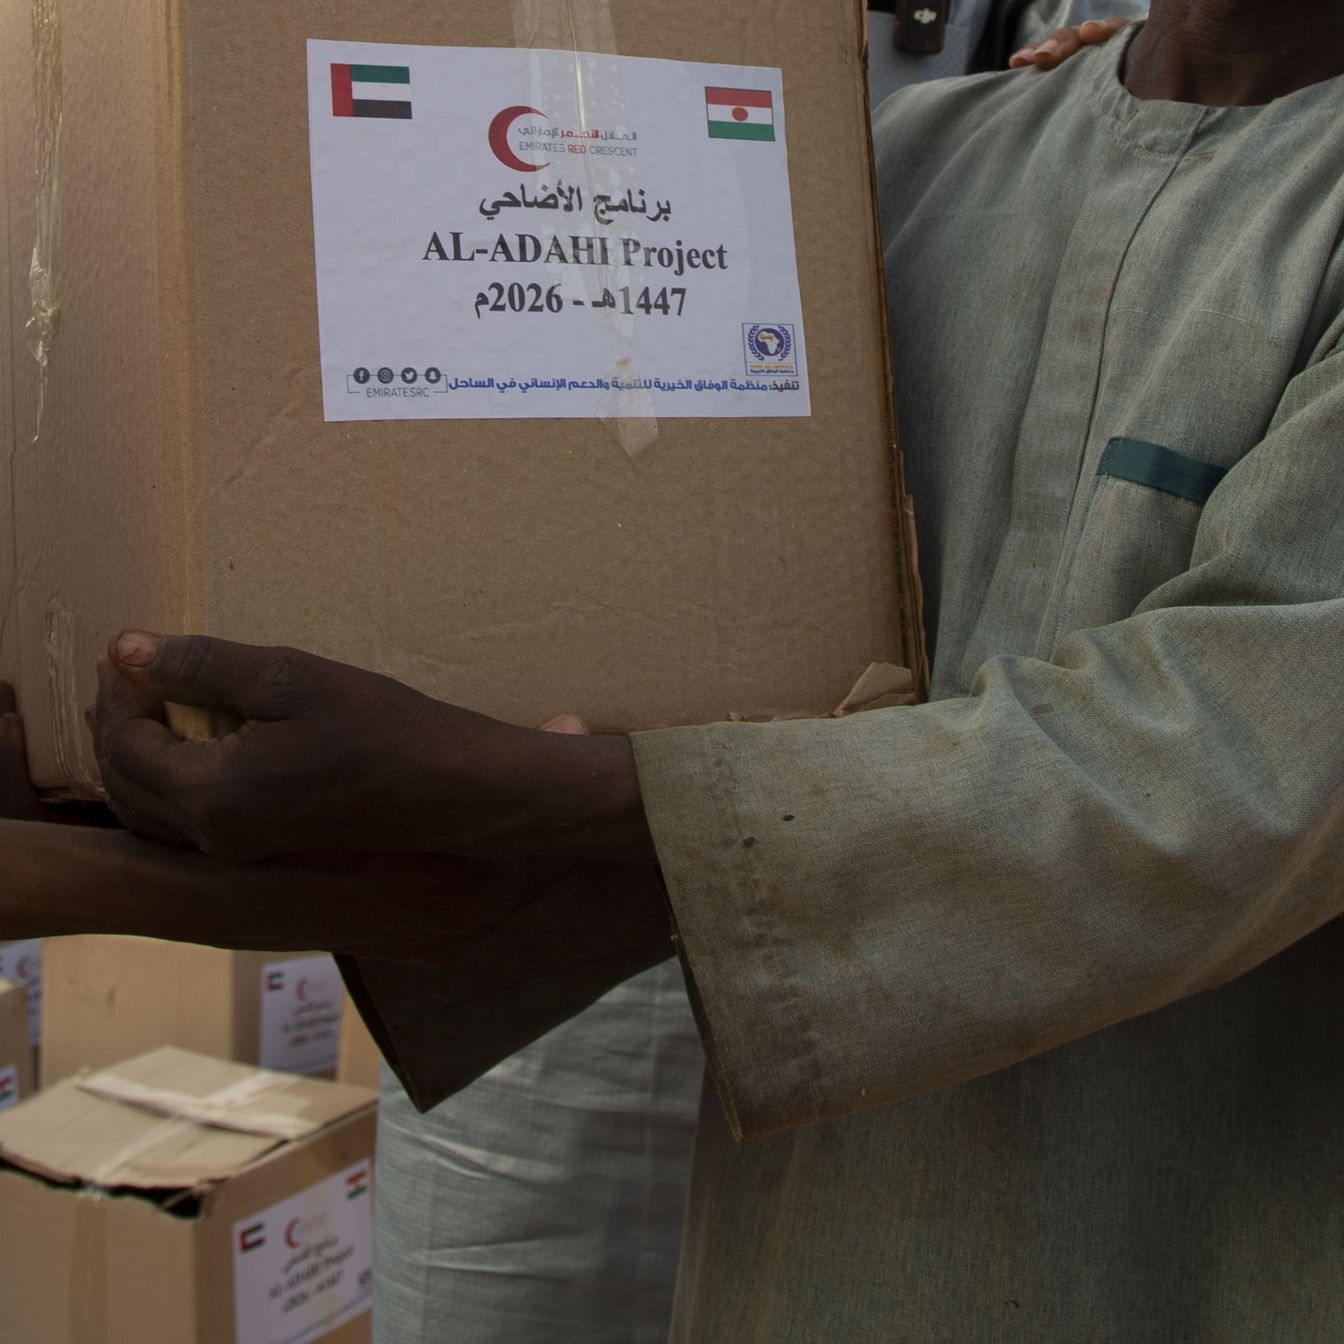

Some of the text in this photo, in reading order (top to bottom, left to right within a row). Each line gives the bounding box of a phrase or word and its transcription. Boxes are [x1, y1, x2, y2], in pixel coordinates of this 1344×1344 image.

[519, 141, 638, 156] EMIRATES RED CRESCENT
[479, 179, 672, 225] برنامج الأضاحي
[422, 231, 729, 276] AL-ADAHI Project
[474, 281, 564, 319] 2026م
[448, 377, 494, 391] الساحل
[496, 377, 517, 394] في
[518, 377, 566, 393] الإنساني
[568, 378, 610, 391] والدعم
[654, 379, 692, 392] الخيرية
[694, 380, 728, 391] الوفاق
[730, 379, 768, 391] منظمة
[769, 380, 800, 391] تنفيذ:
[366, 387, 430, 398] EMIRATESRC
